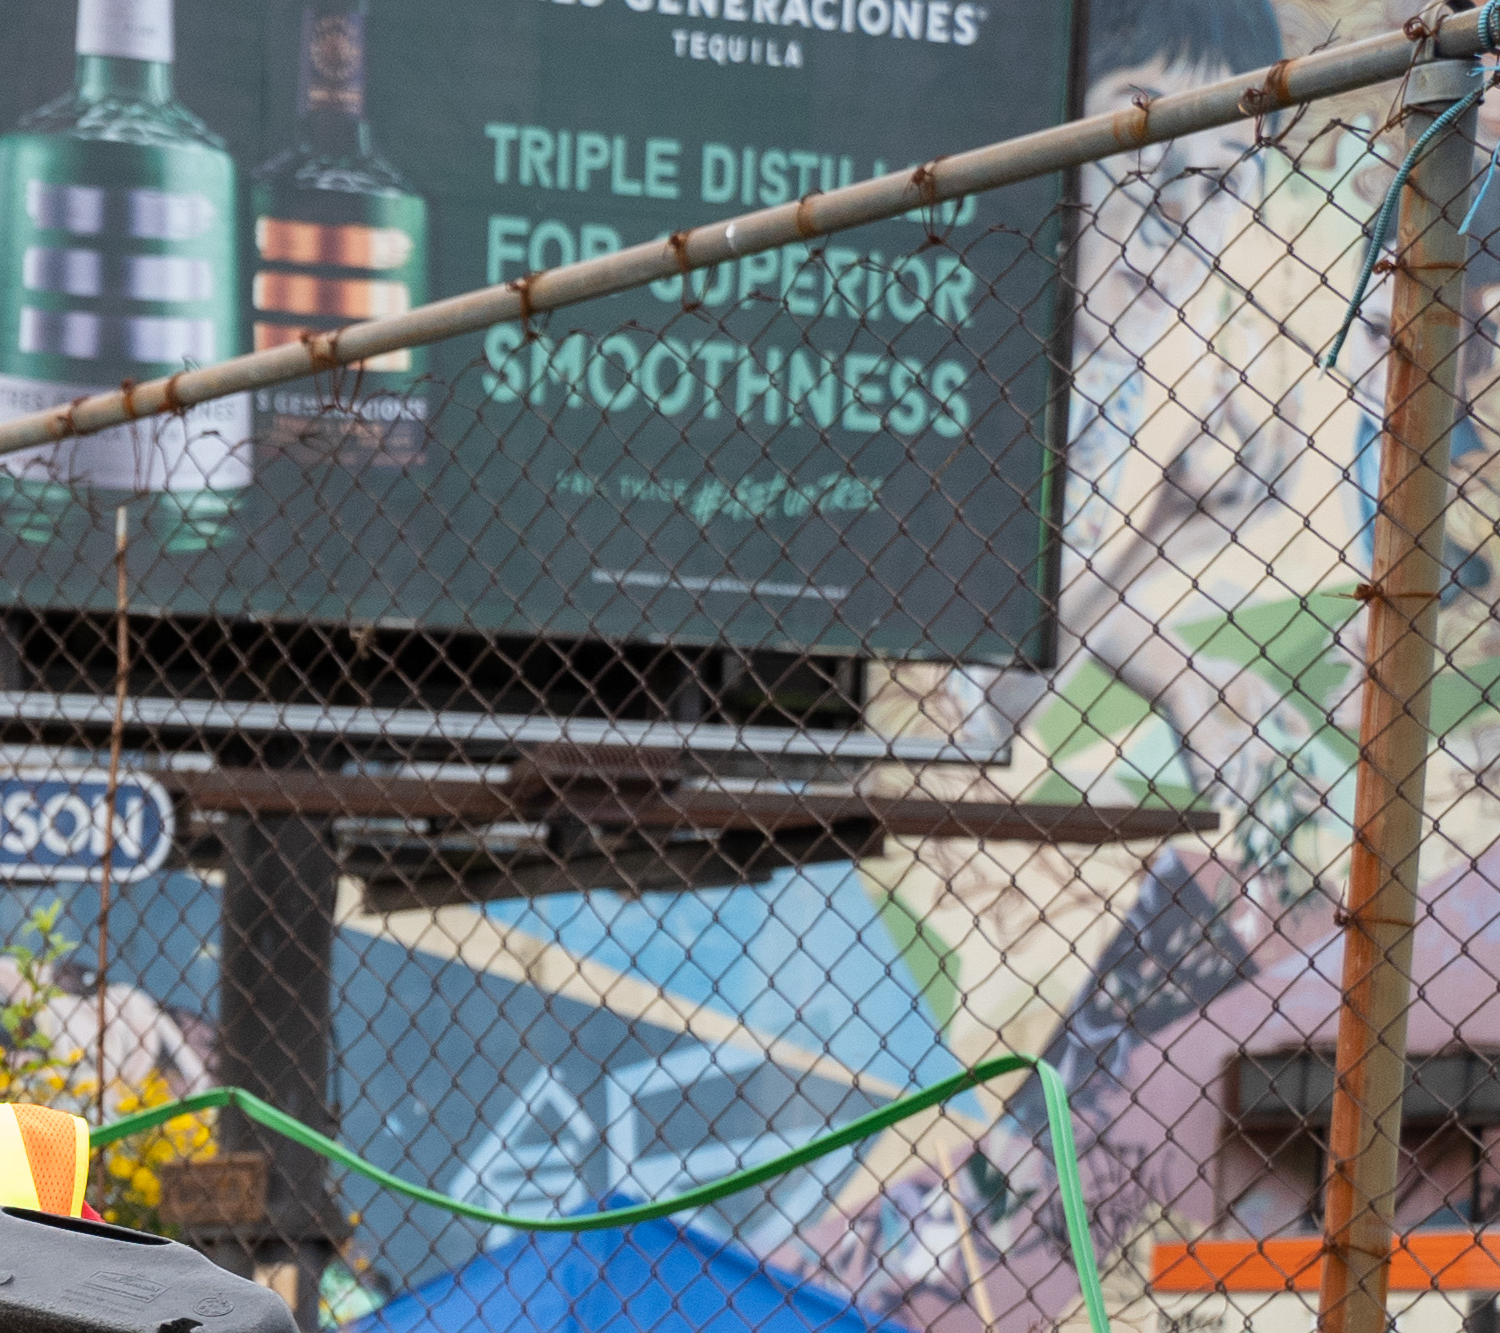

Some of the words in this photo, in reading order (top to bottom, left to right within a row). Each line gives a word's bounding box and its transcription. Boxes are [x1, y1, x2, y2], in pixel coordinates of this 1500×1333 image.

[672, 29, 803, 68] TEQUILA
[484, 123, 681, 199] TRIPLE
[702, 142, 978, 226] DISTI
[482, 322, 972, 438] SMOOTHNESS
